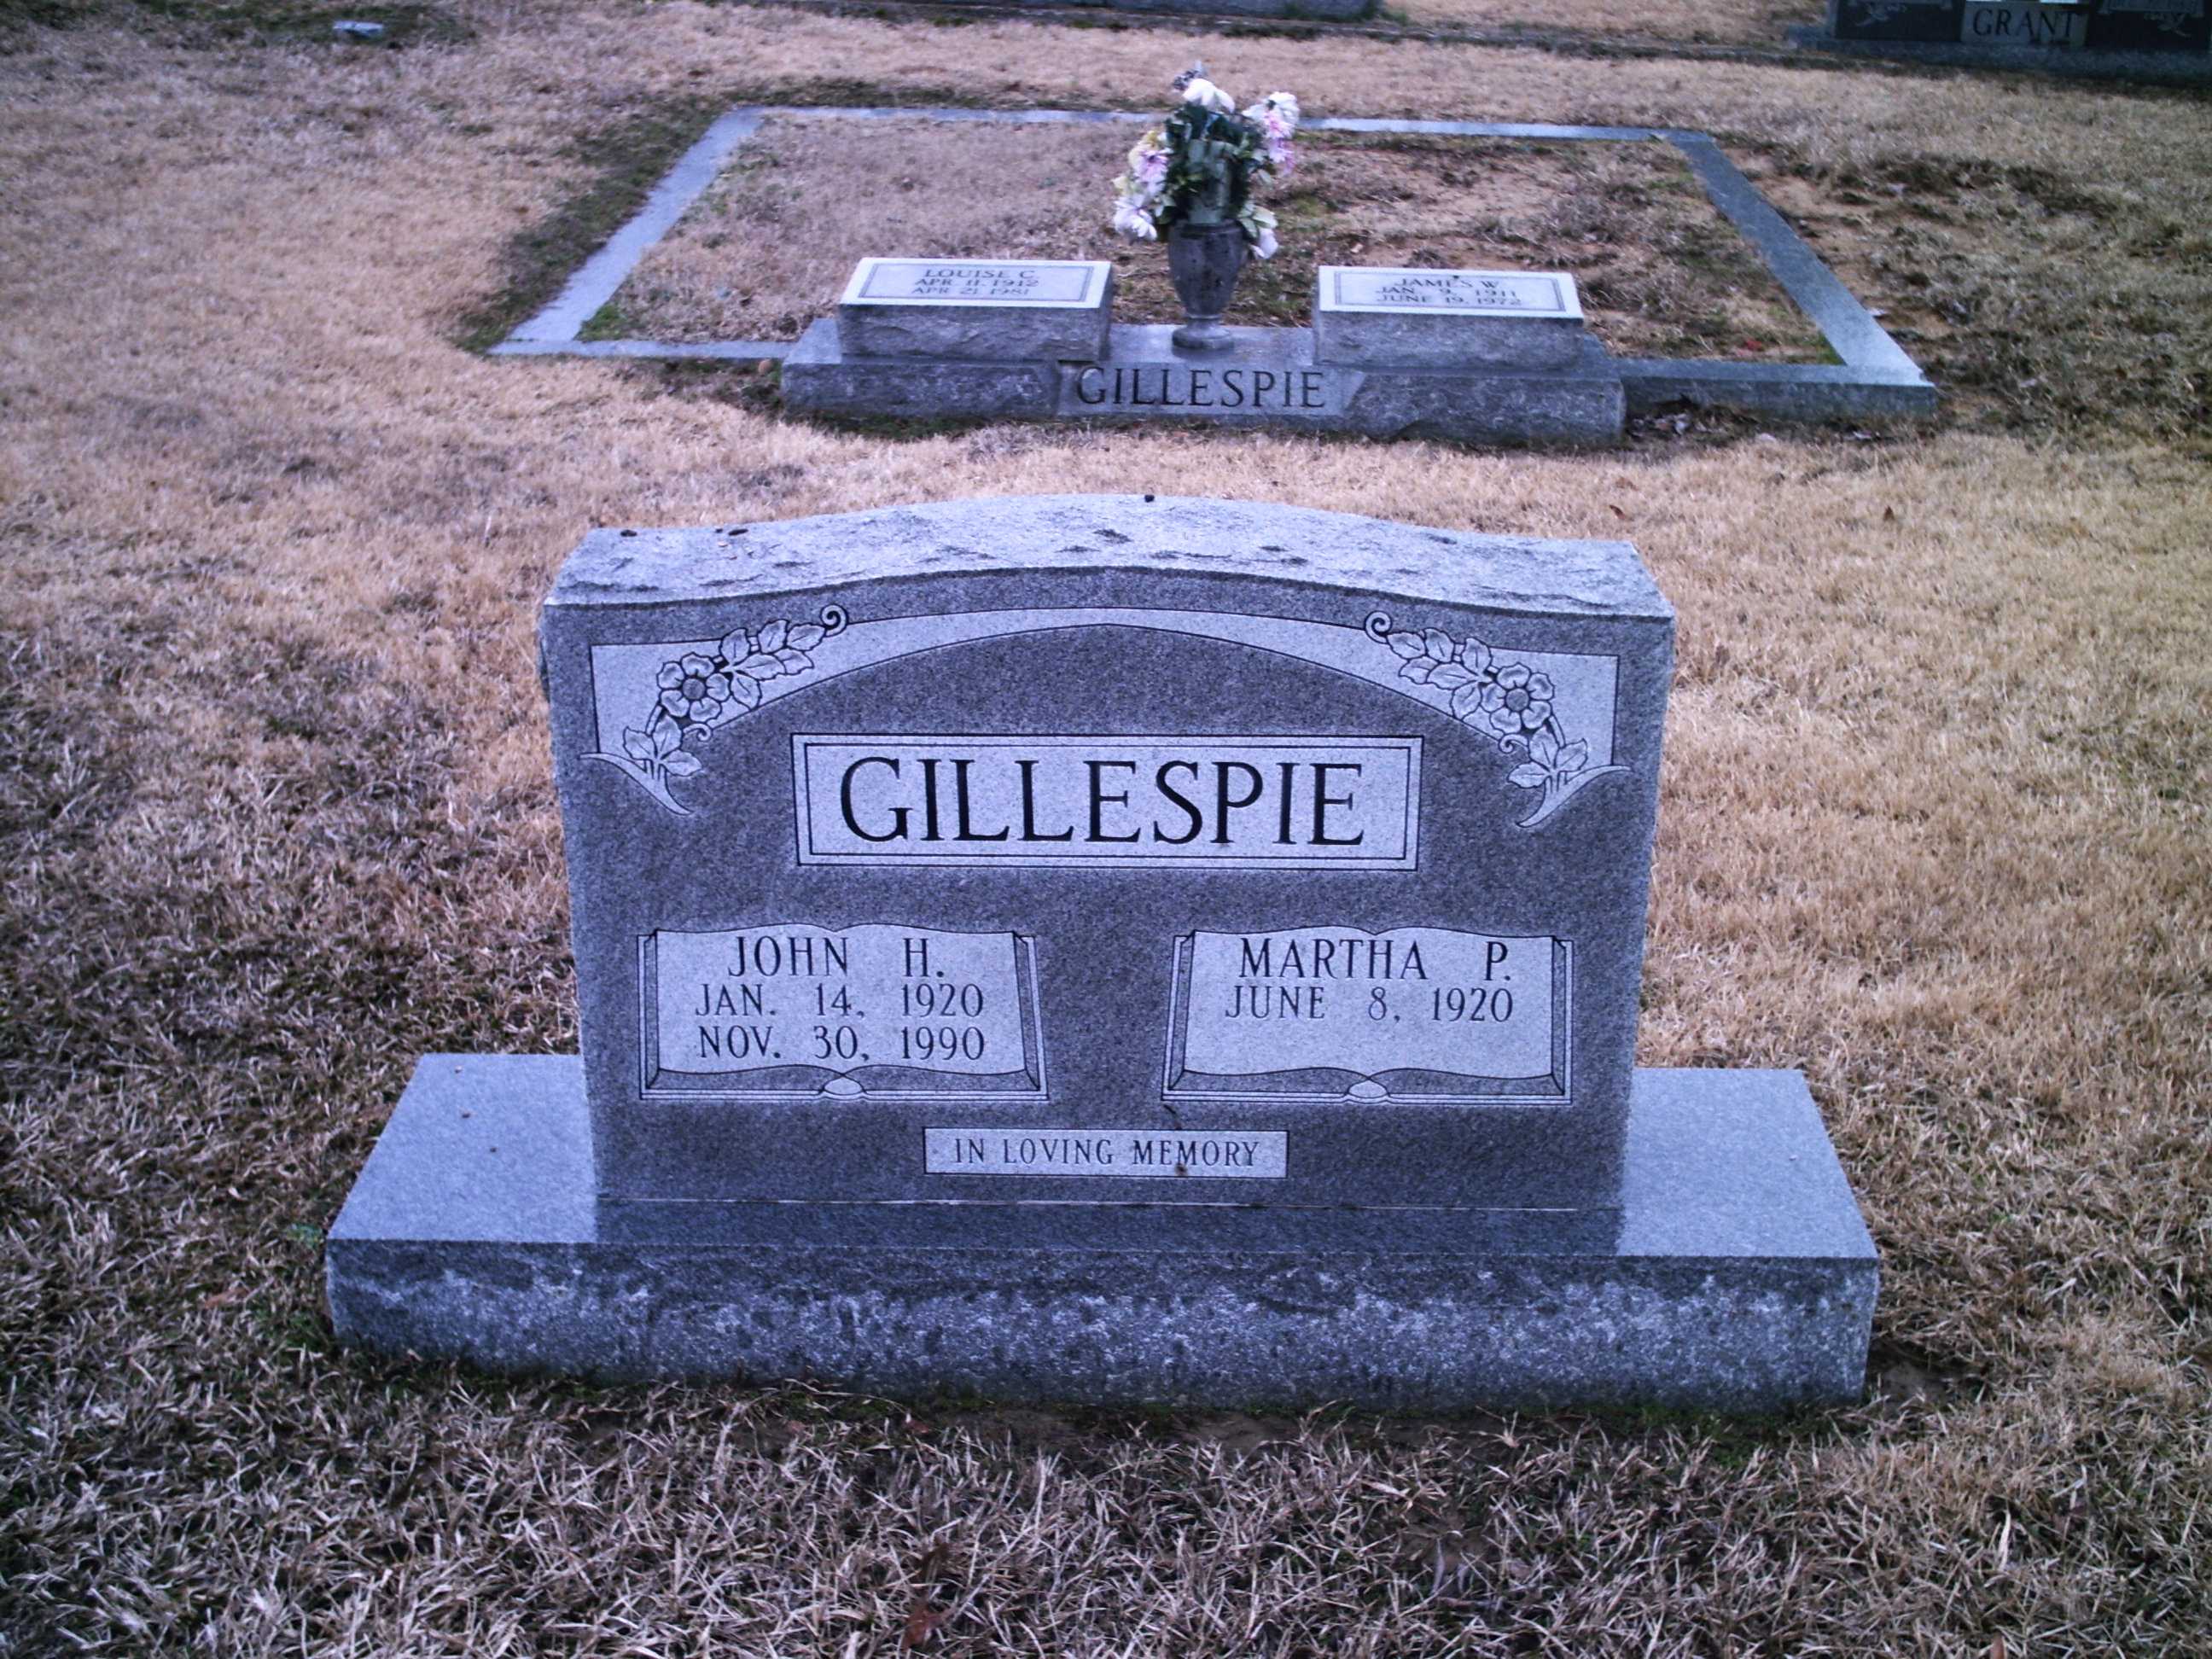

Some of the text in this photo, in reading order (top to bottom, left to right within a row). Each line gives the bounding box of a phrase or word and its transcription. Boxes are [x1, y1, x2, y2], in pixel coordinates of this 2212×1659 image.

[1972, 7, 2077, 39] GRANT
[923, 269, 1010, 278] LOUISE
[1394, 278, 1473, 288] JAMES
[1377, 294, 1432, 304] JUNE
[1476, 297, 1522, 306] 1972
[1076, 366, 1326, 408] GILLESPIE
[839, 756, 1365, 846] GILLESPIE
[727, 935, 945, 978] JOHN H.
[1238, 937, 1511, 981] MARTHA P.
[695, 982, 985, 1019] JAN. 14, 1920
[1225, 985, 1514, 1023] JUNE 8, 1920
[699, 1025, 986, 1062] NOV. 30, 1990
[953, 1138, 1260, 1167] IN LOVING MEMORY
